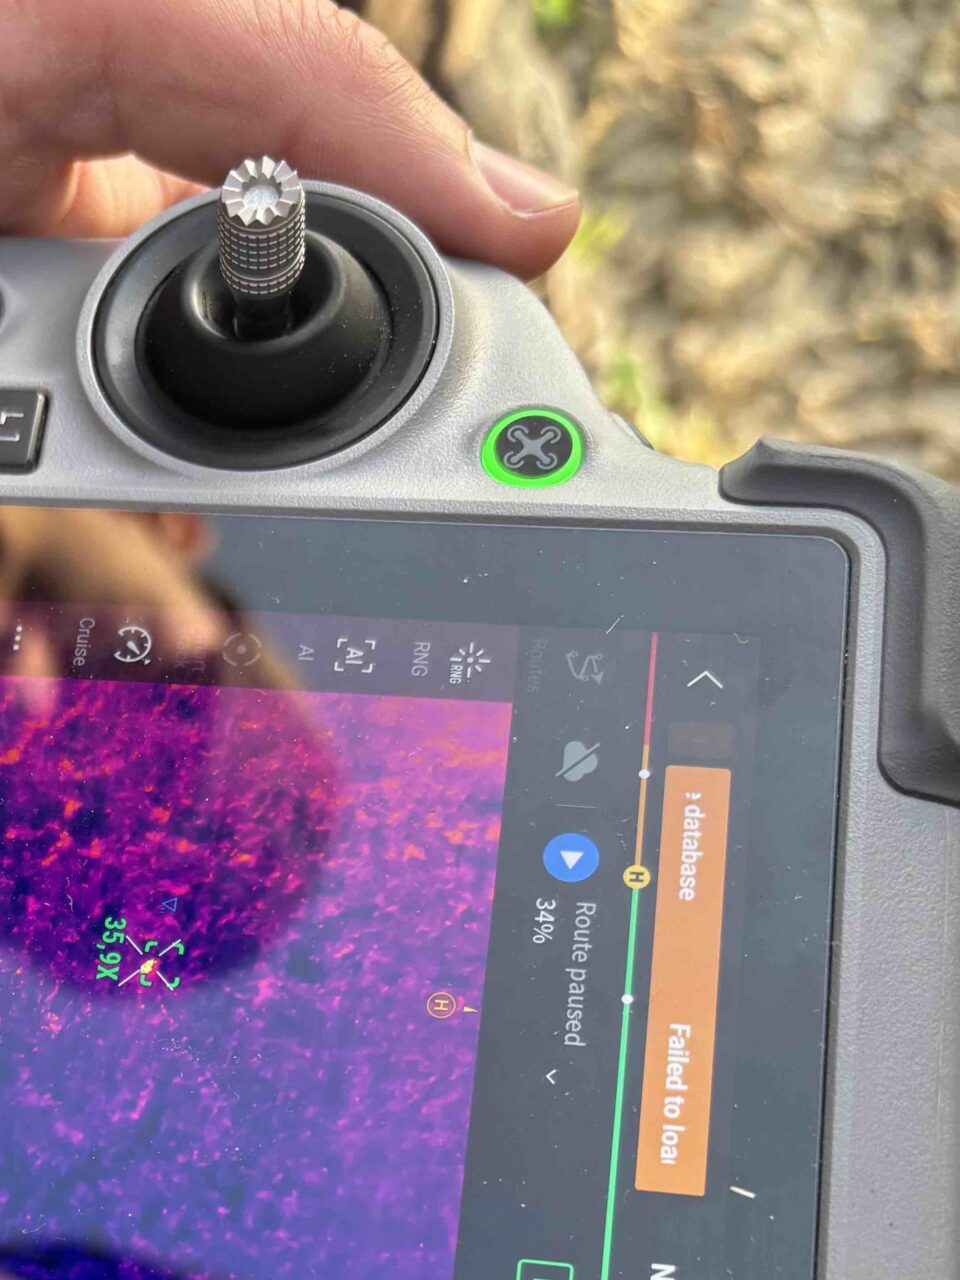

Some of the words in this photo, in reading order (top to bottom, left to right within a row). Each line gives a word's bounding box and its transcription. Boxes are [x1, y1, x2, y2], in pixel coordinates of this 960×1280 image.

[72, 617, 96, 666] Cruise
[298, 644, 314, 661] AI
[345, 647, 364, 664] AI
[411, 642, 431, 677] RNG
[526, 639, 547, 693] Routes
[449, 664, 463, 684] RNG
[679, 805, 706, 901] database
[532, 898, 556, 944] 34%
[571, 902, 597, 962] Route
[96, 916, 126, 980] 35,9X
[563, 968, 587, 1047] paused
[664, 1023, 691, 1090] Failed
[663, 1095, 684, 1118] to
